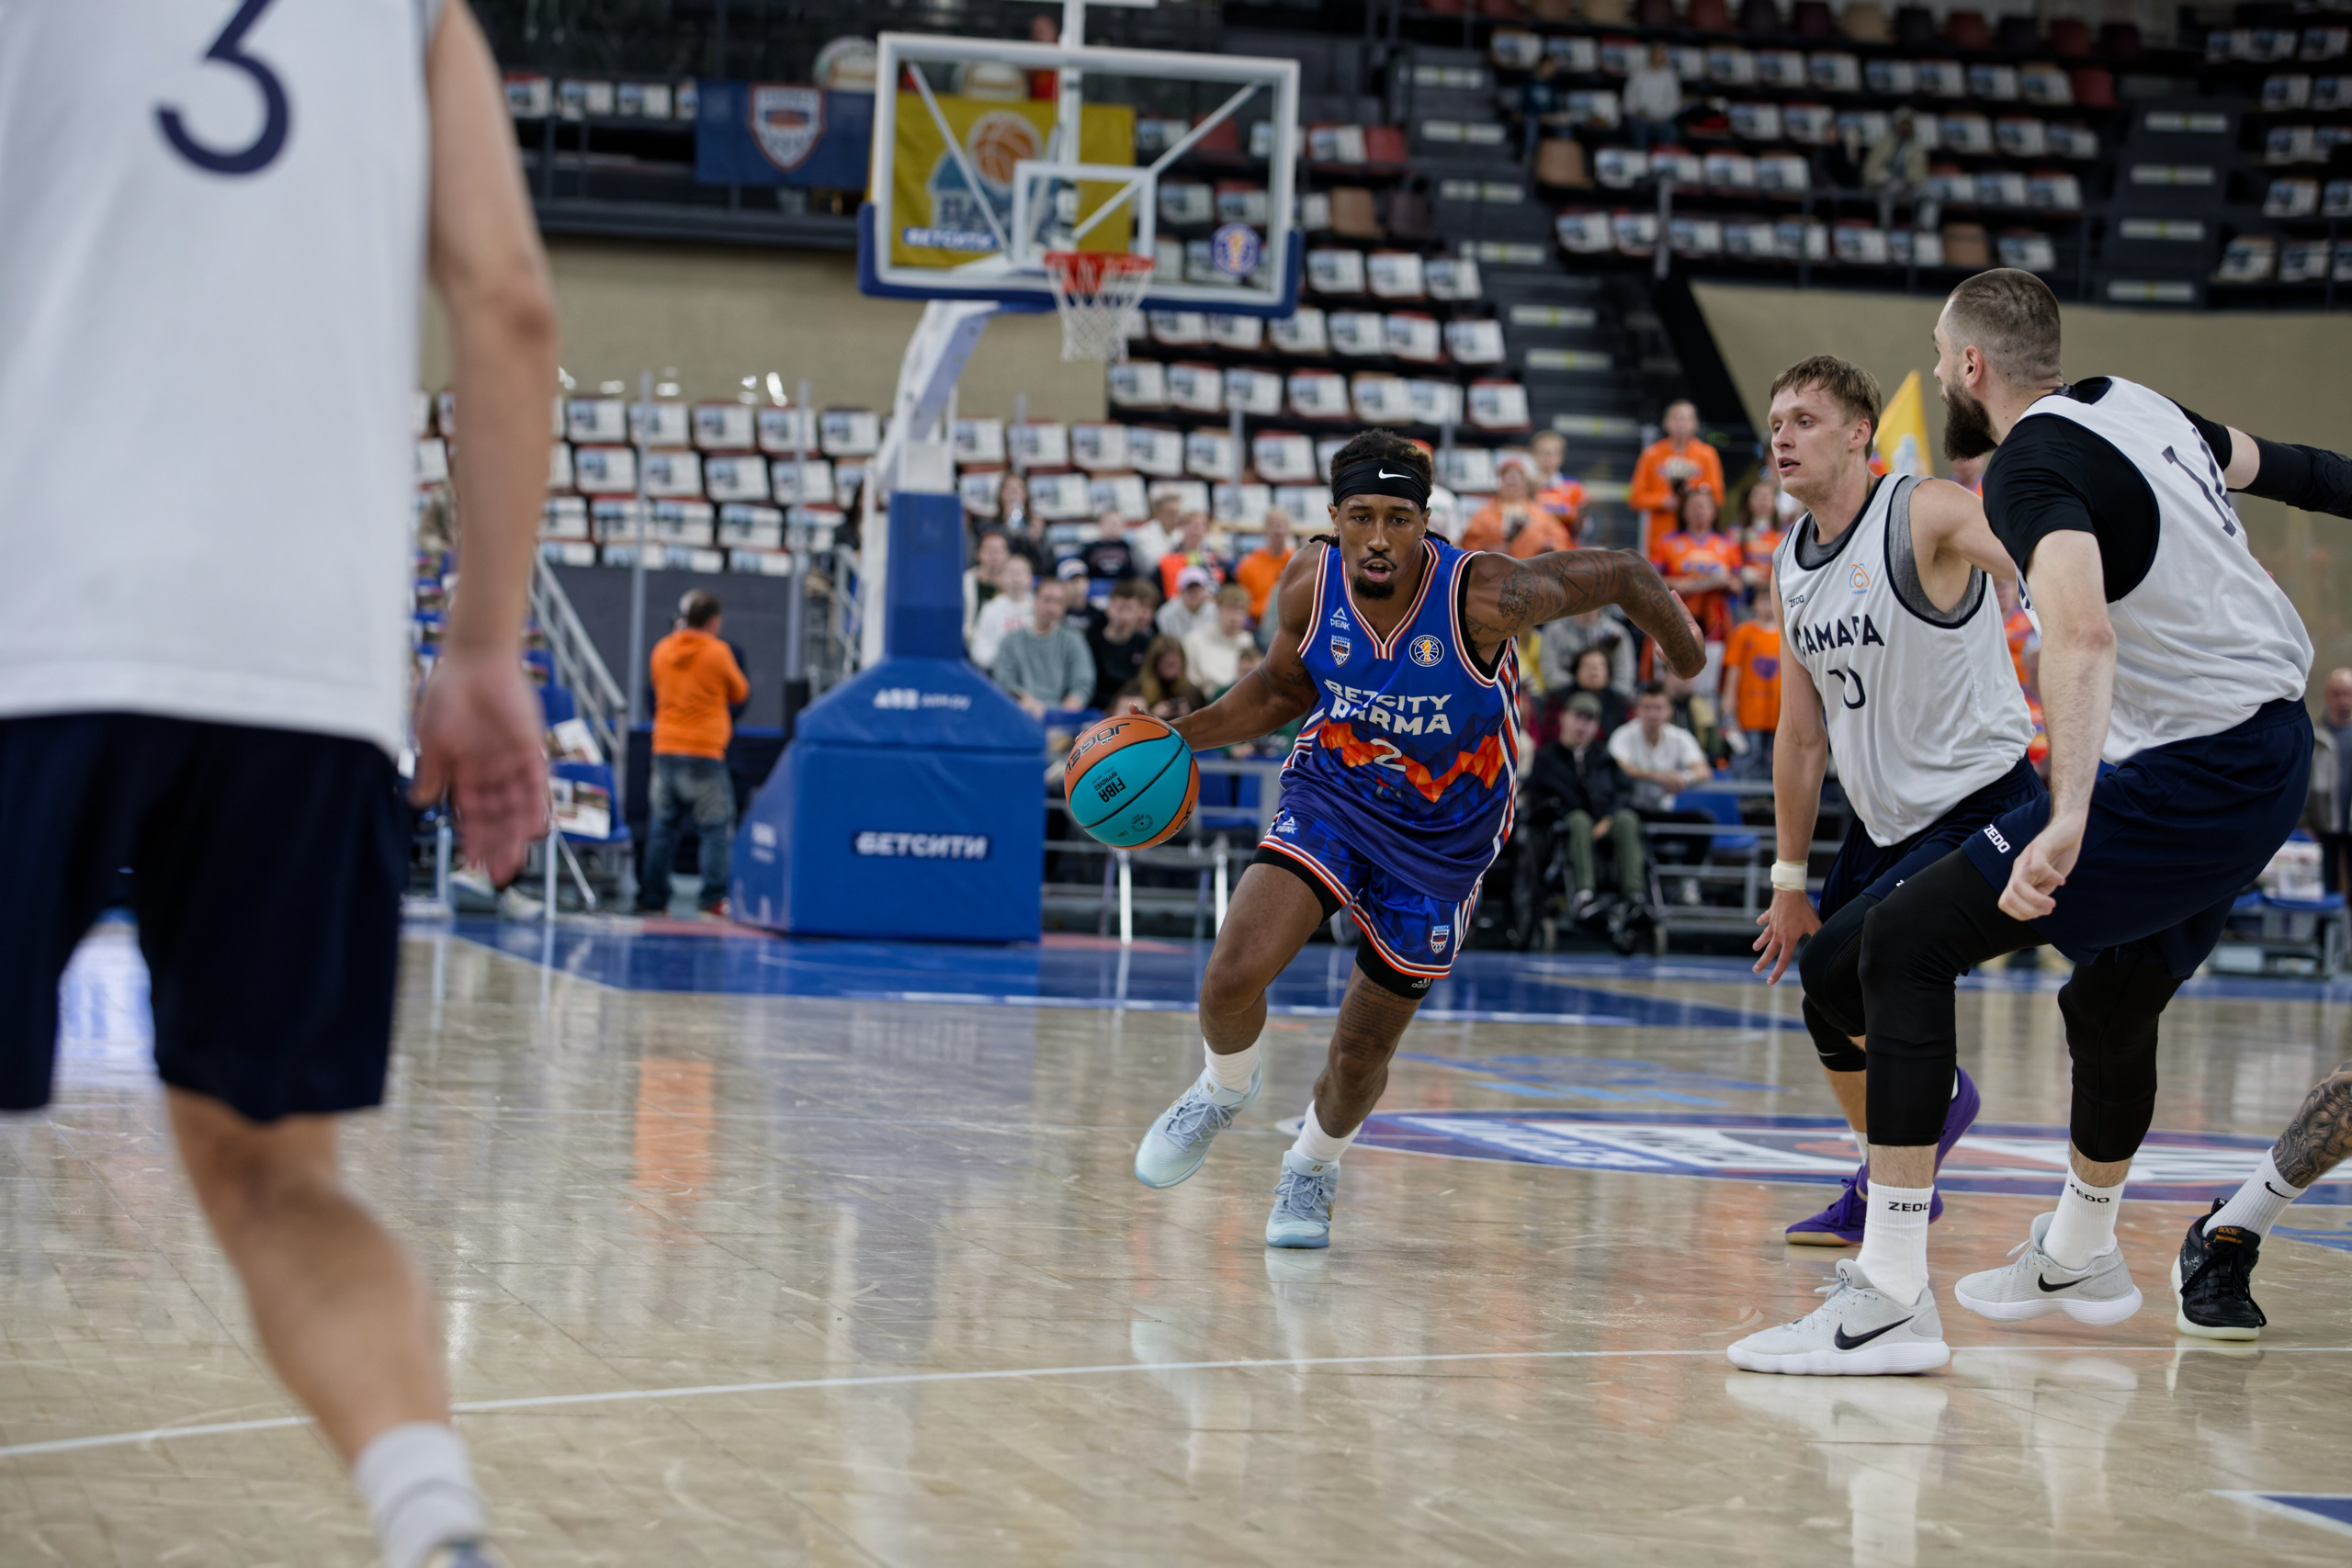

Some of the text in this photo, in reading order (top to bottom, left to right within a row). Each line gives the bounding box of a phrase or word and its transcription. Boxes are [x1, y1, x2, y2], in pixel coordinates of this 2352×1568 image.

[154, 0, 291, 176] 3
[1329, 617, 1351, 631] PEAK
[1324, 679, 1453, 714] BETCITY
[1329, 694, 1453, 736] PARMA
[1370, 738, 1407, 773] 2
[1093, 771, 1118, 791] APPROVED
[1098, 776, 1127, 803] FIBA
[855, 830, 989, 860] БЕТСИТИ
[1983, 823, 2011, 854] ZEDO
